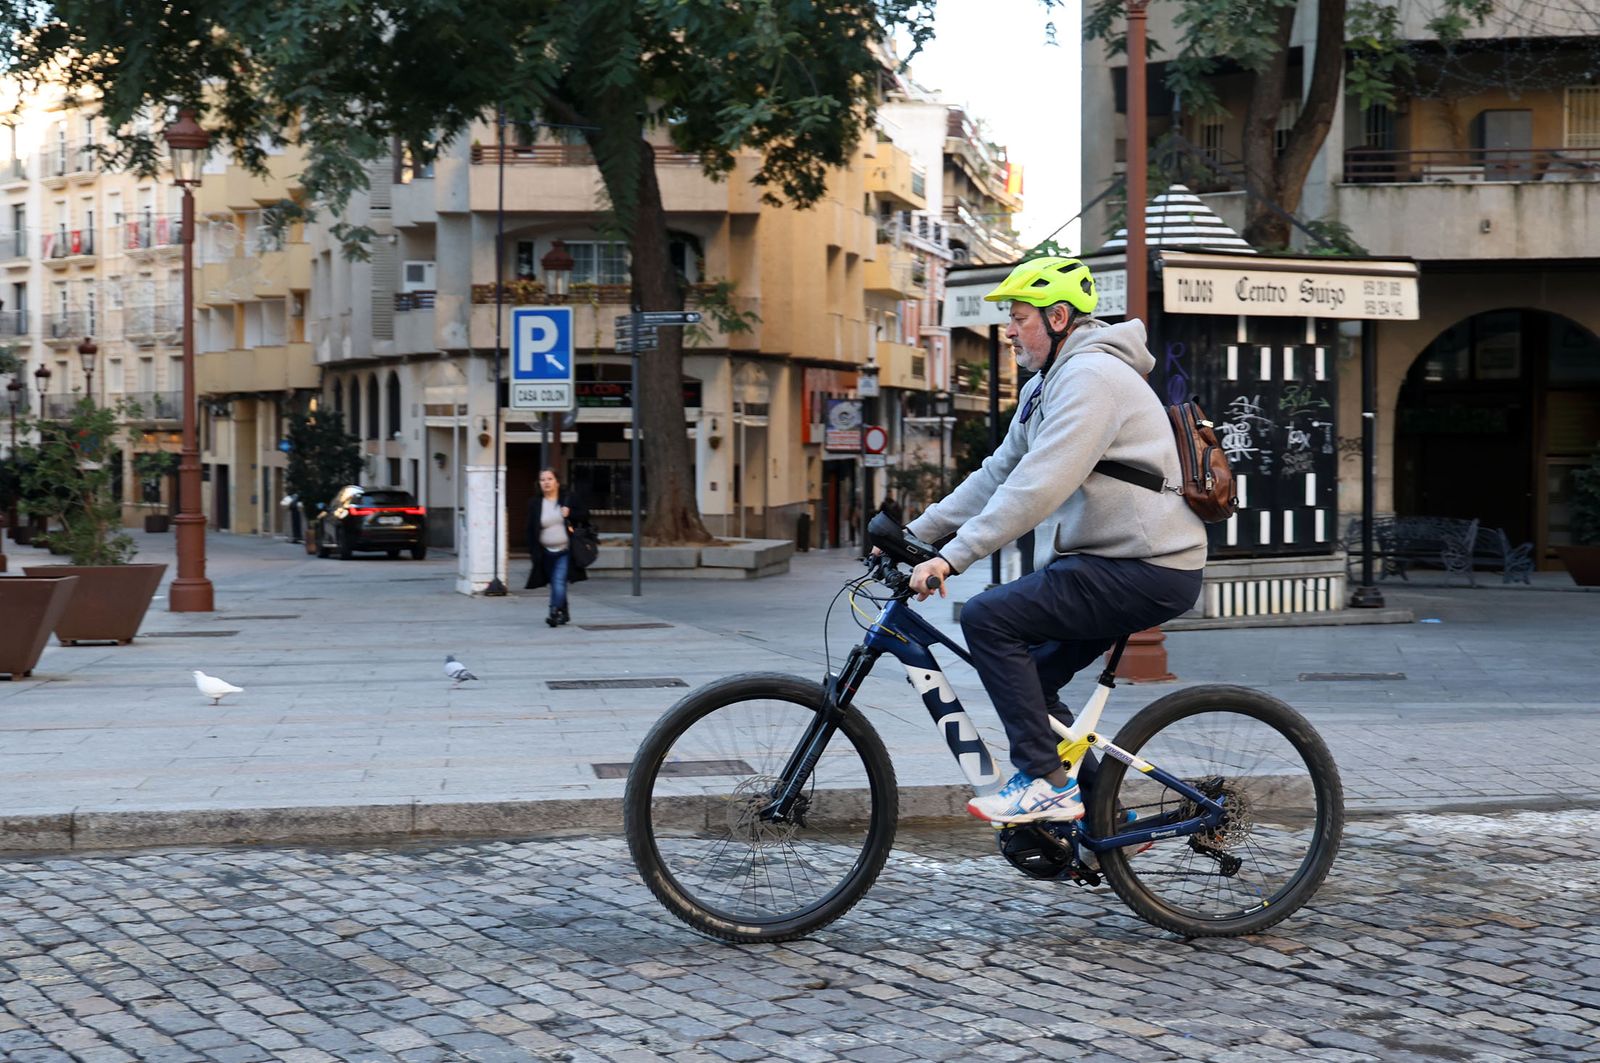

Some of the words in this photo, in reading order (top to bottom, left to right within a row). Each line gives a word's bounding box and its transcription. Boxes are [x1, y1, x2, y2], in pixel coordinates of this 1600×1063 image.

[1177, 278, 1213, 303] TOLDOS
[1235, 275, 1288, 303] Centro
[1298, 277, 1346, 311] Suizo
[518, 315, 557, 372] P
[517, 389, 537, 402] CASA
[541, 389, 565, 402] COLON
